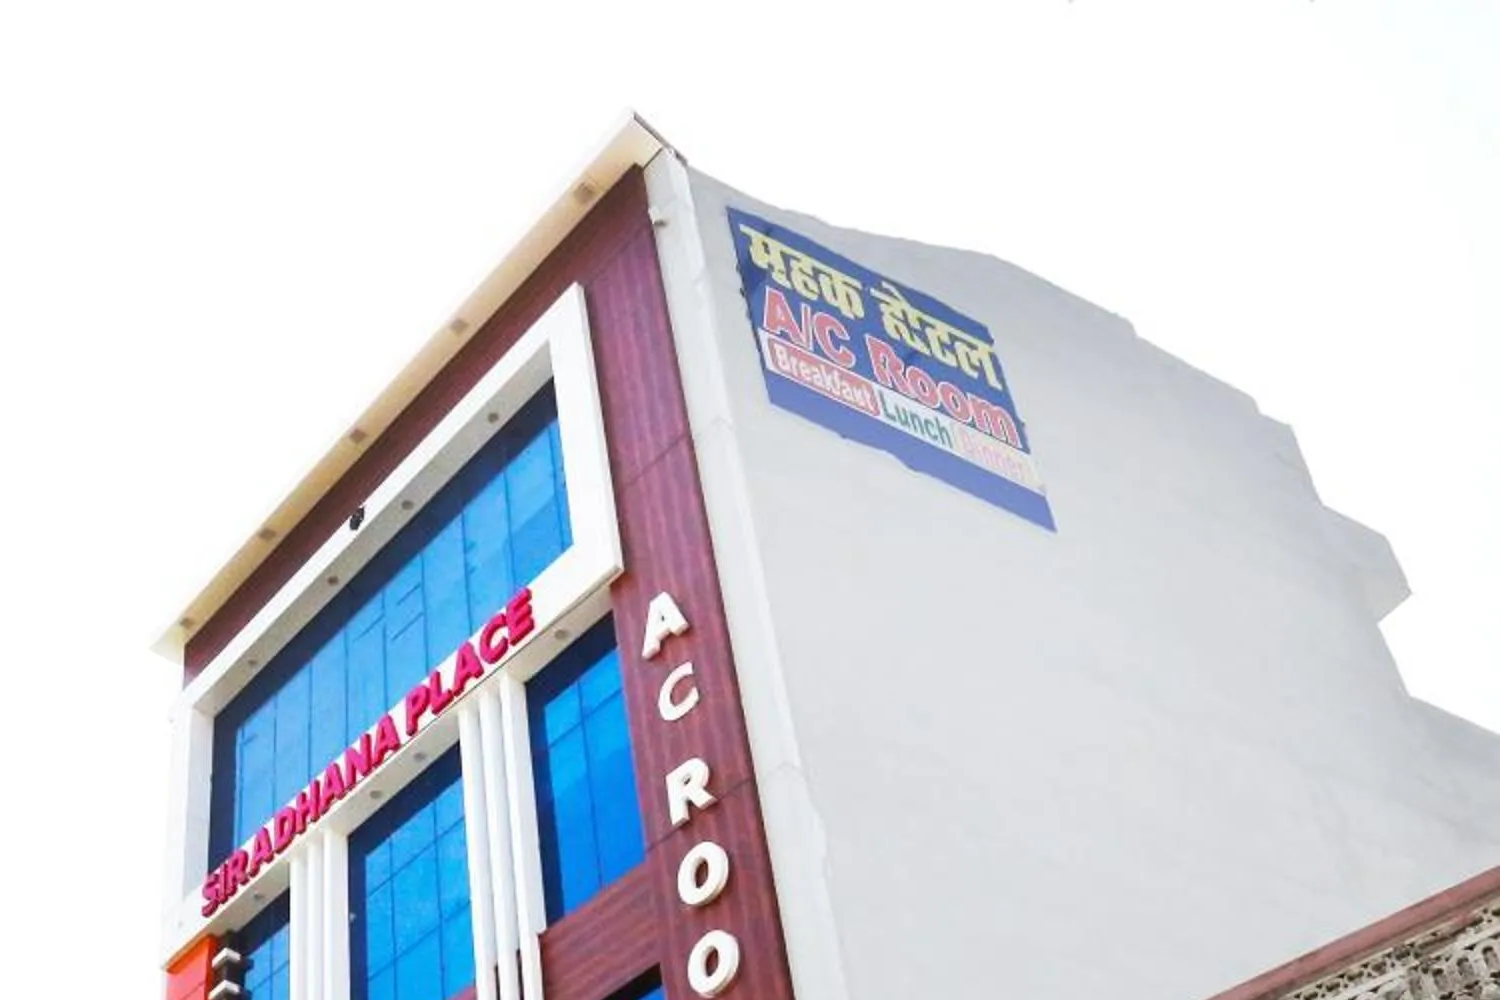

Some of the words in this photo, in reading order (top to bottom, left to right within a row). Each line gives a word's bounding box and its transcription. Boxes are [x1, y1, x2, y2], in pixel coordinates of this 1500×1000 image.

[763, 286, 856, 369] A/C
[865, 333, 1023, 449] Room
[772, 341, 878, 416] Breakfast
[878, 388, 953, 449] Lunch
[405, 587, 536, 737] PLACE
